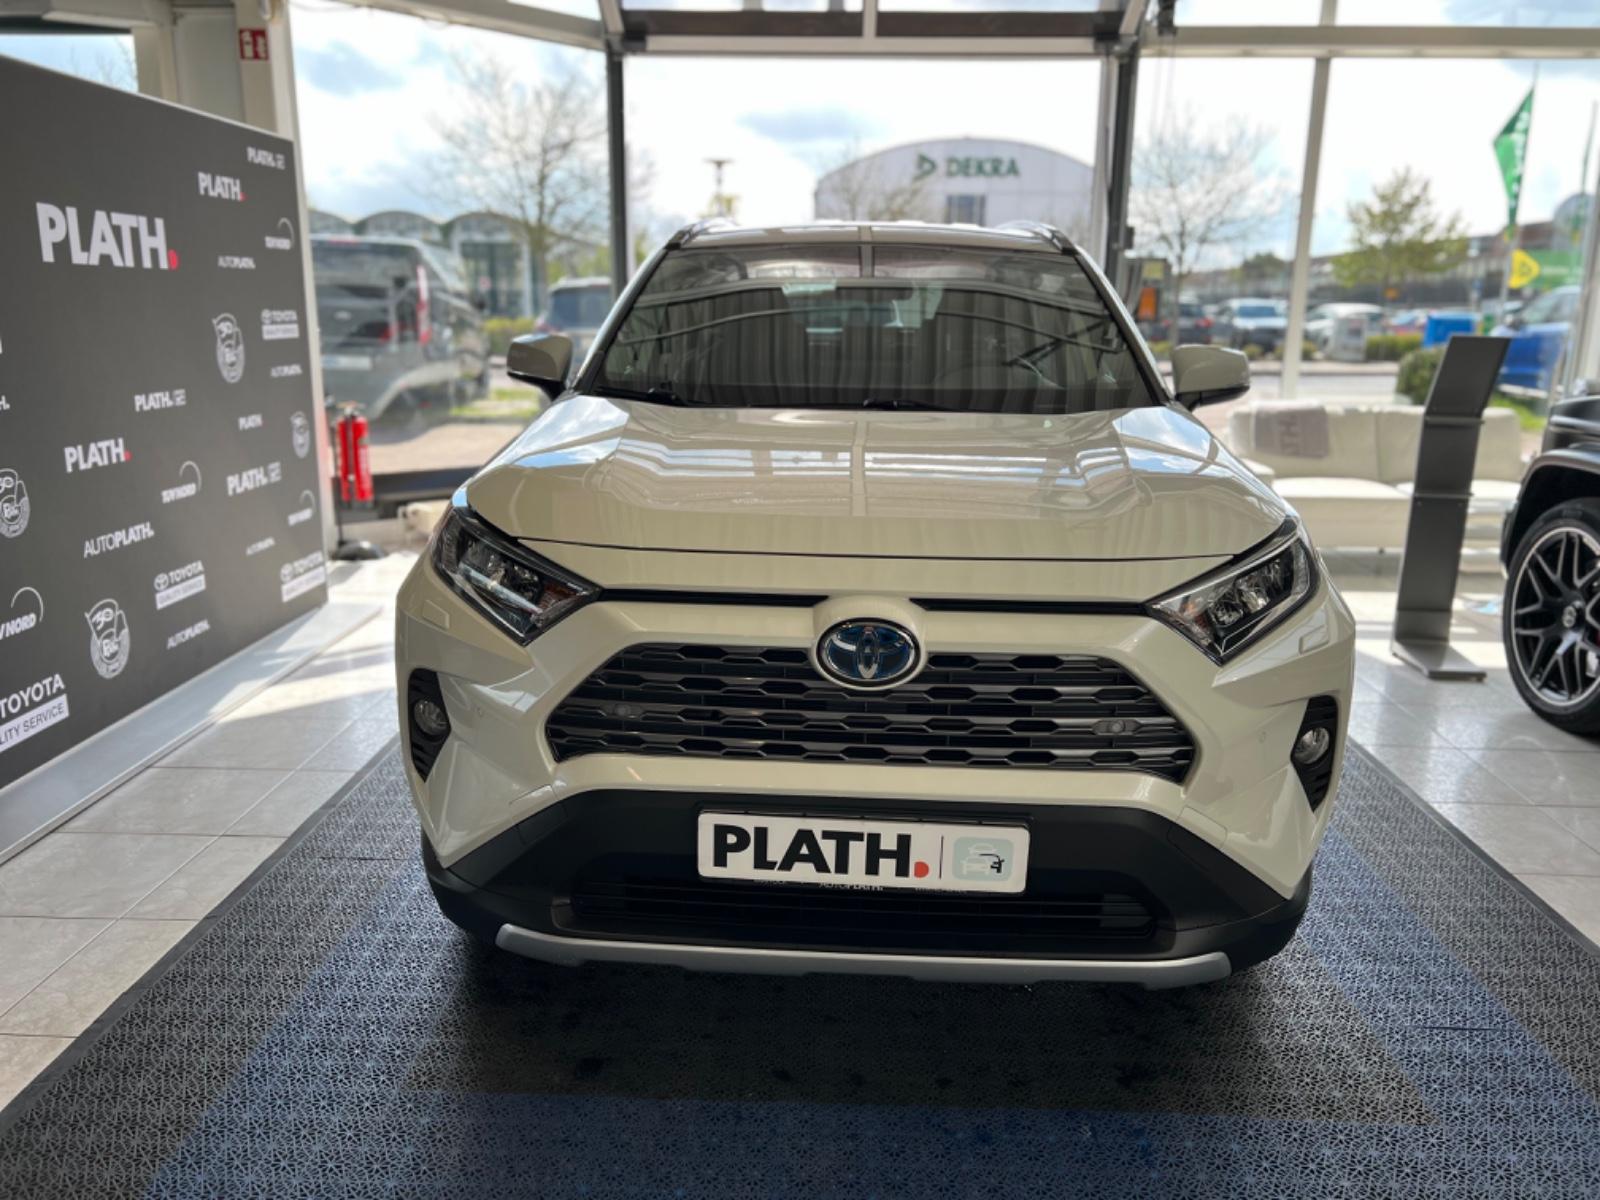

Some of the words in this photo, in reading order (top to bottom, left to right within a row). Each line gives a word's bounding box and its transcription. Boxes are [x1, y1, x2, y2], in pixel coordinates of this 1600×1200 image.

[945, 157, 1020, 178] DEKRA
[198, 172, 245, 202] PLATH.
[37, 202, 178, 270] PLATH.
[64, 437, 132, 472] PLATH.
[83, 522, 155, 557] AUTOPLATH.
[168, 560, 204, 585] TOYOTA
[23, 702, 64, 733] SERVICE
[713, 824, 930, 878] PLATH.
